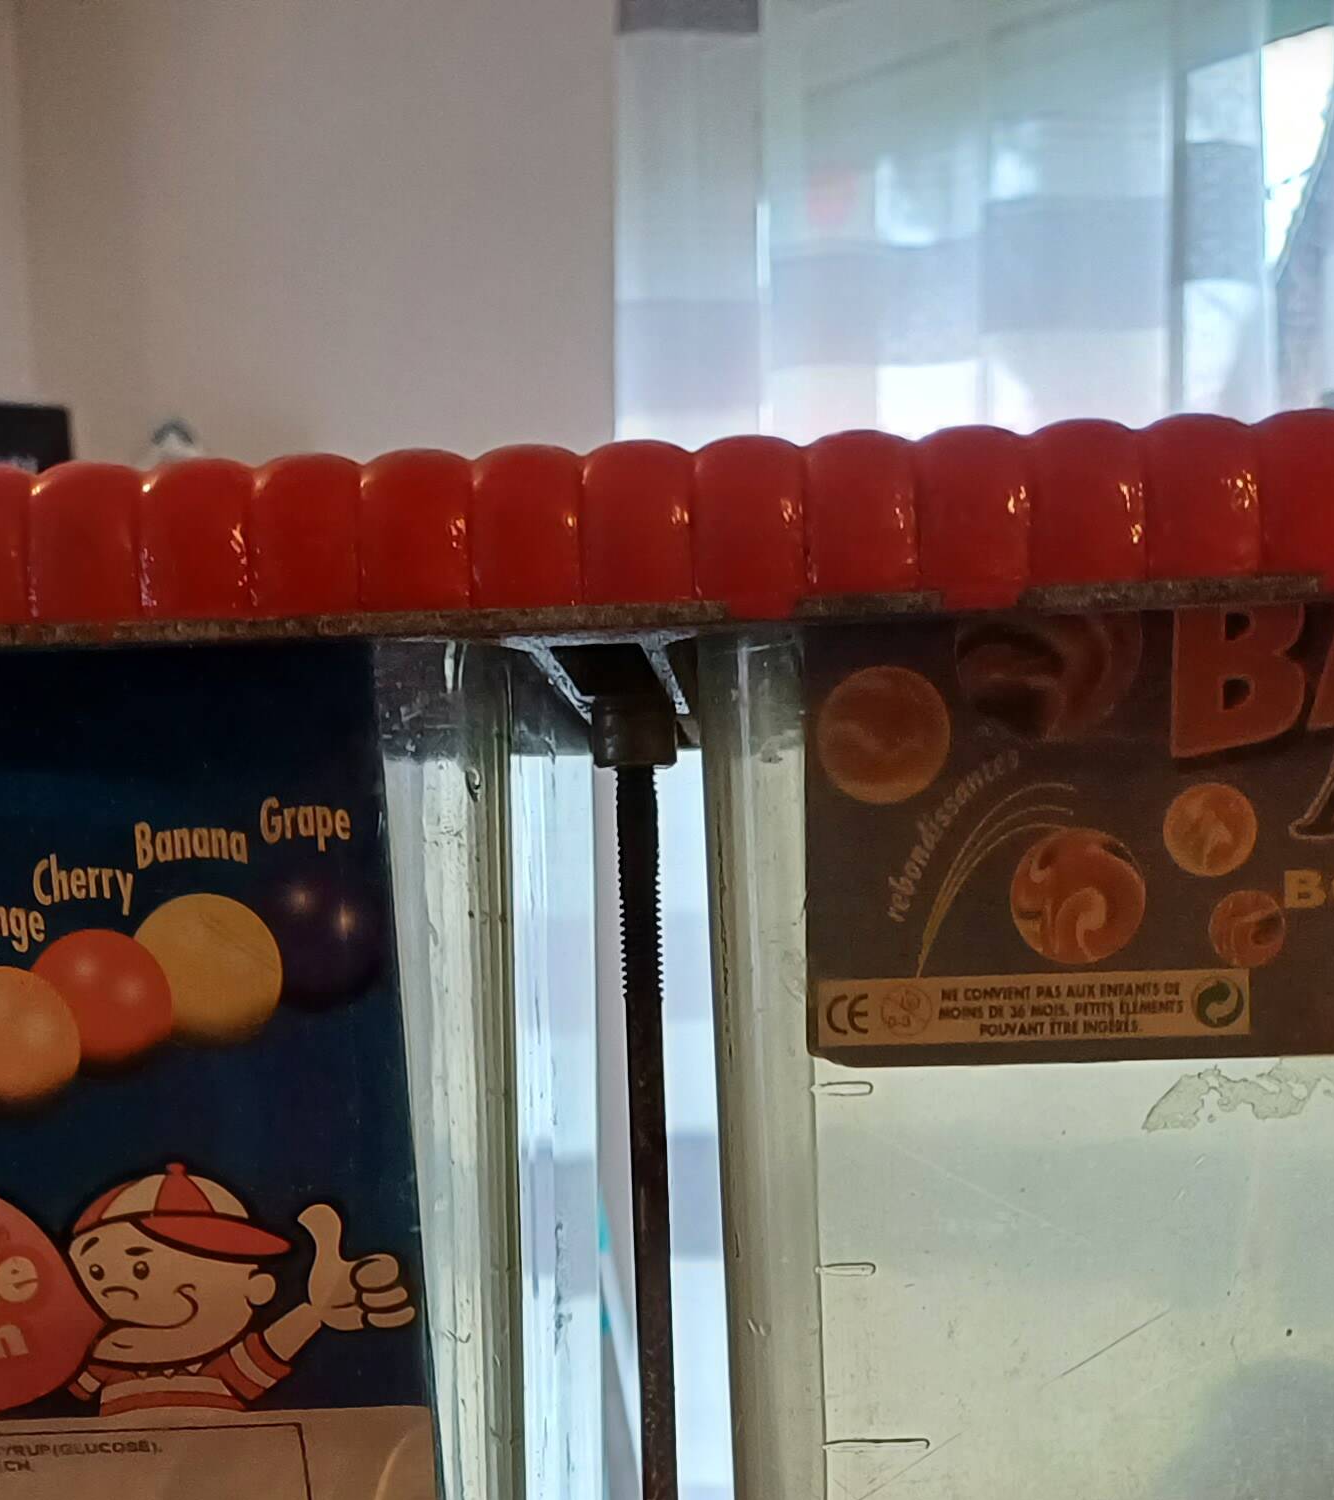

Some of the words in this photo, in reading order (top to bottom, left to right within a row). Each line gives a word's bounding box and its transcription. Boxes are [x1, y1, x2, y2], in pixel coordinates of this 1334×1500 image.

[260, 797, 351, 852] Grape
[134, 821, 249, 870] Banana
[33, 853, 134, 916] Cherry
[963, 985, 1032, 1001] CONVIENT
[1036, 984, 1062, 999] PAS
[1067, 983, 1096, 999] AUX
[1100, 982, 1160, 998] ENFANTS
[938, 1005, 985, 1021] MOINS
[1009, 1004, 1027, 1018] 36
[979, 1021, 1044, 1037] POUVANT
